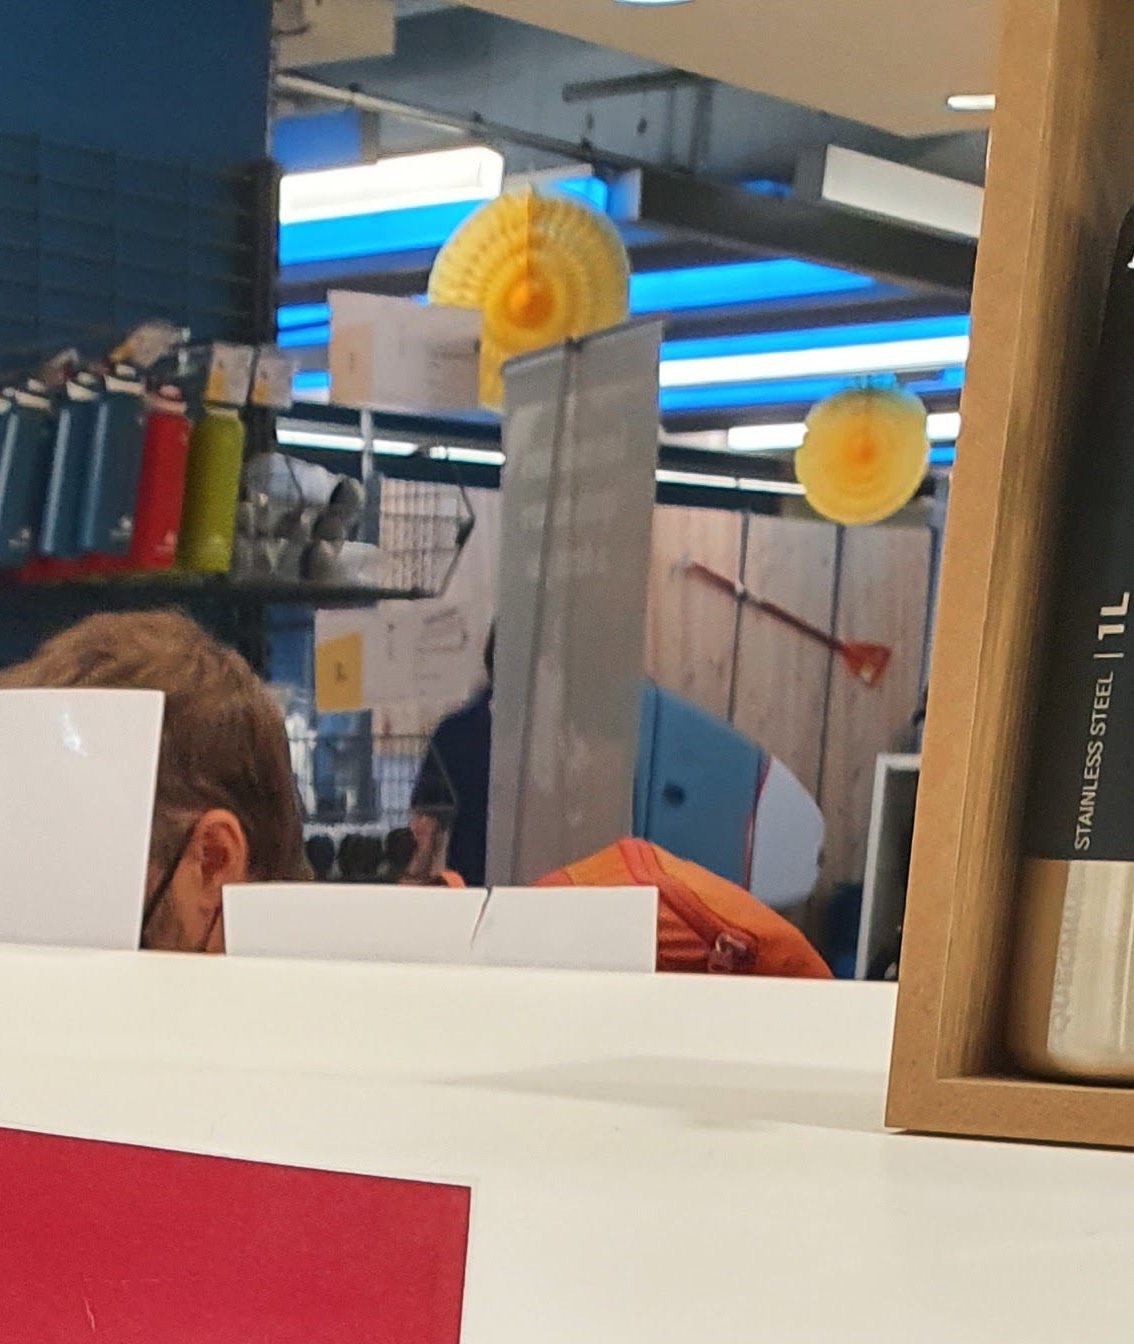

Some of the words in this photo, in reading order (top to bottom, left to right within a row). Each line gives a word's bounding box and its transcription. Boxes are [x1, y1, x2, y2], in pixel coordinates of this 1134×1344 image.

[1097, 591, 1130, 640] 1L
[1090, 671, 1114, 736] STEEL
[1074, 741, 1104, 850] STAINLESS
